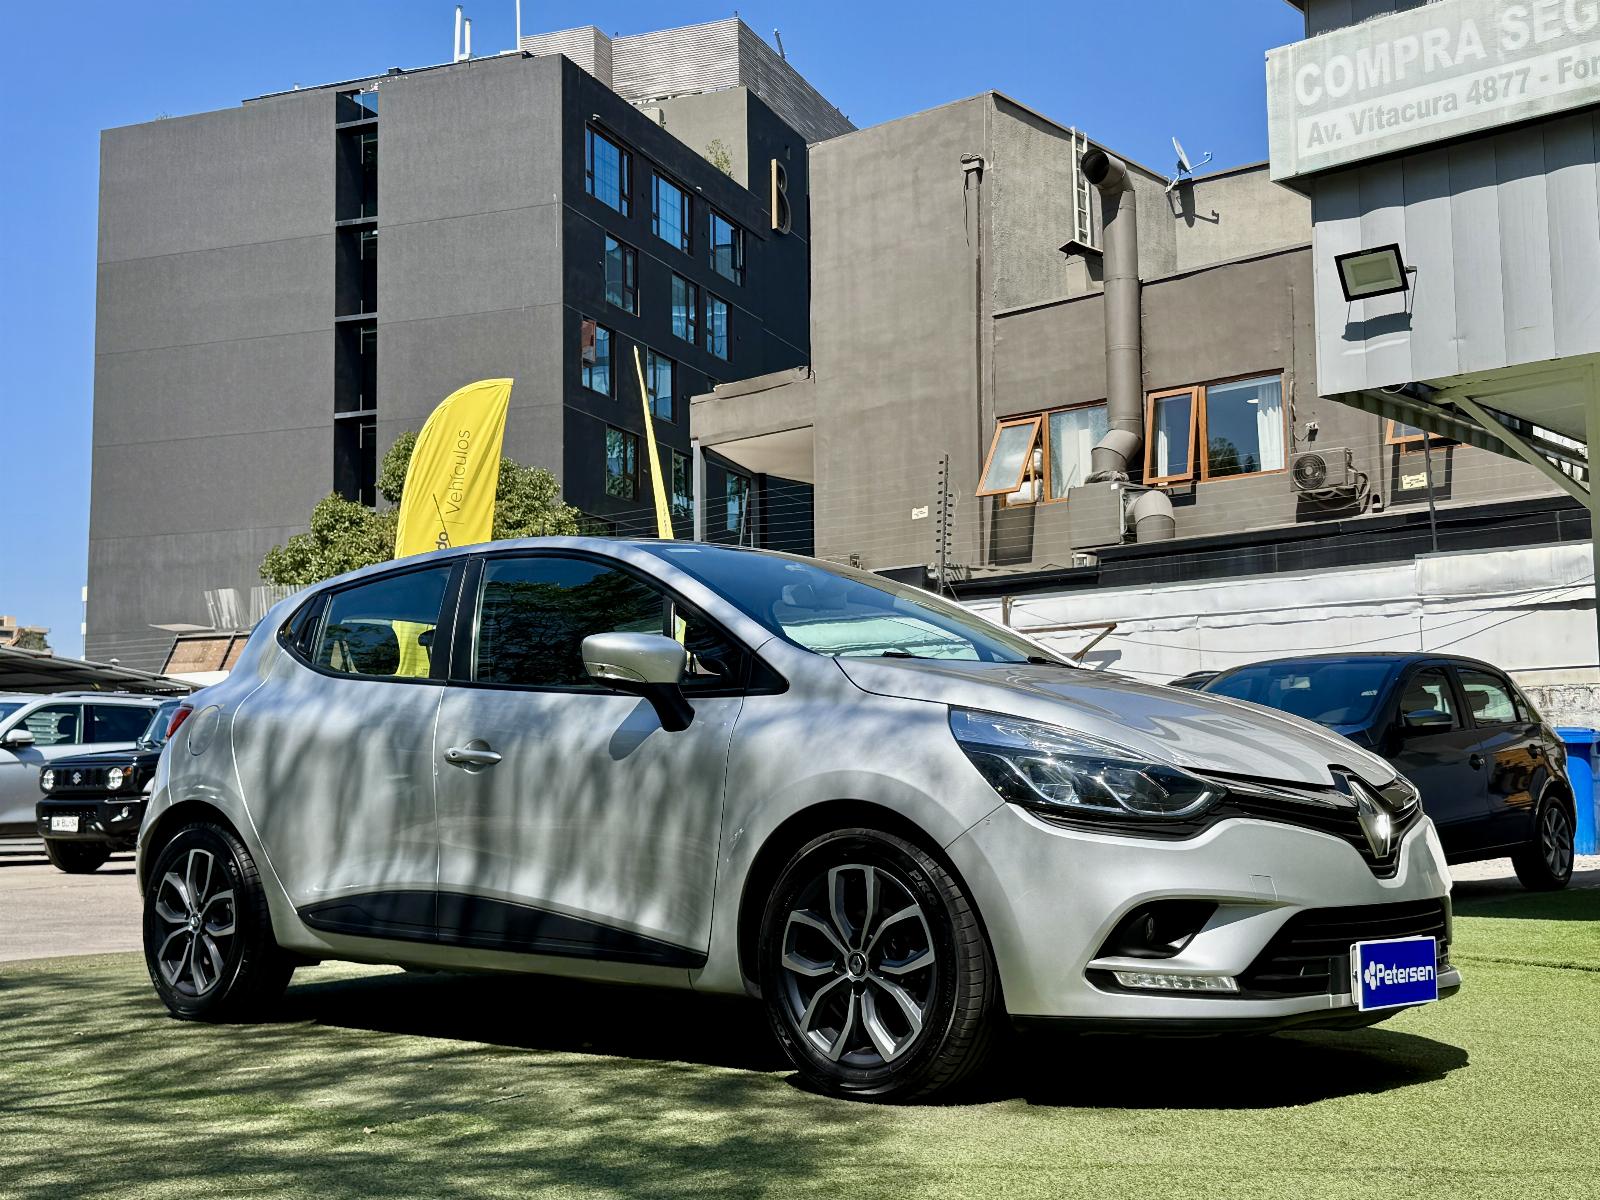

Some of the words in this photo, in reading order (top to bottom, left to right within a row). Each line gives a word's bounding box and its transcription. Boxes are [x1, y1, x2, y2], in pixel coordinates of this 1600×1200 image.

[1295, 18, 1488, 107] COMPRA
[1306, 121, 1342, 149] Av.
[1348, 91, 1458, 137] Vitacura
[1466, 66, 1532, 106] 4877
[1376, 963, 1434, 987] Petersen
